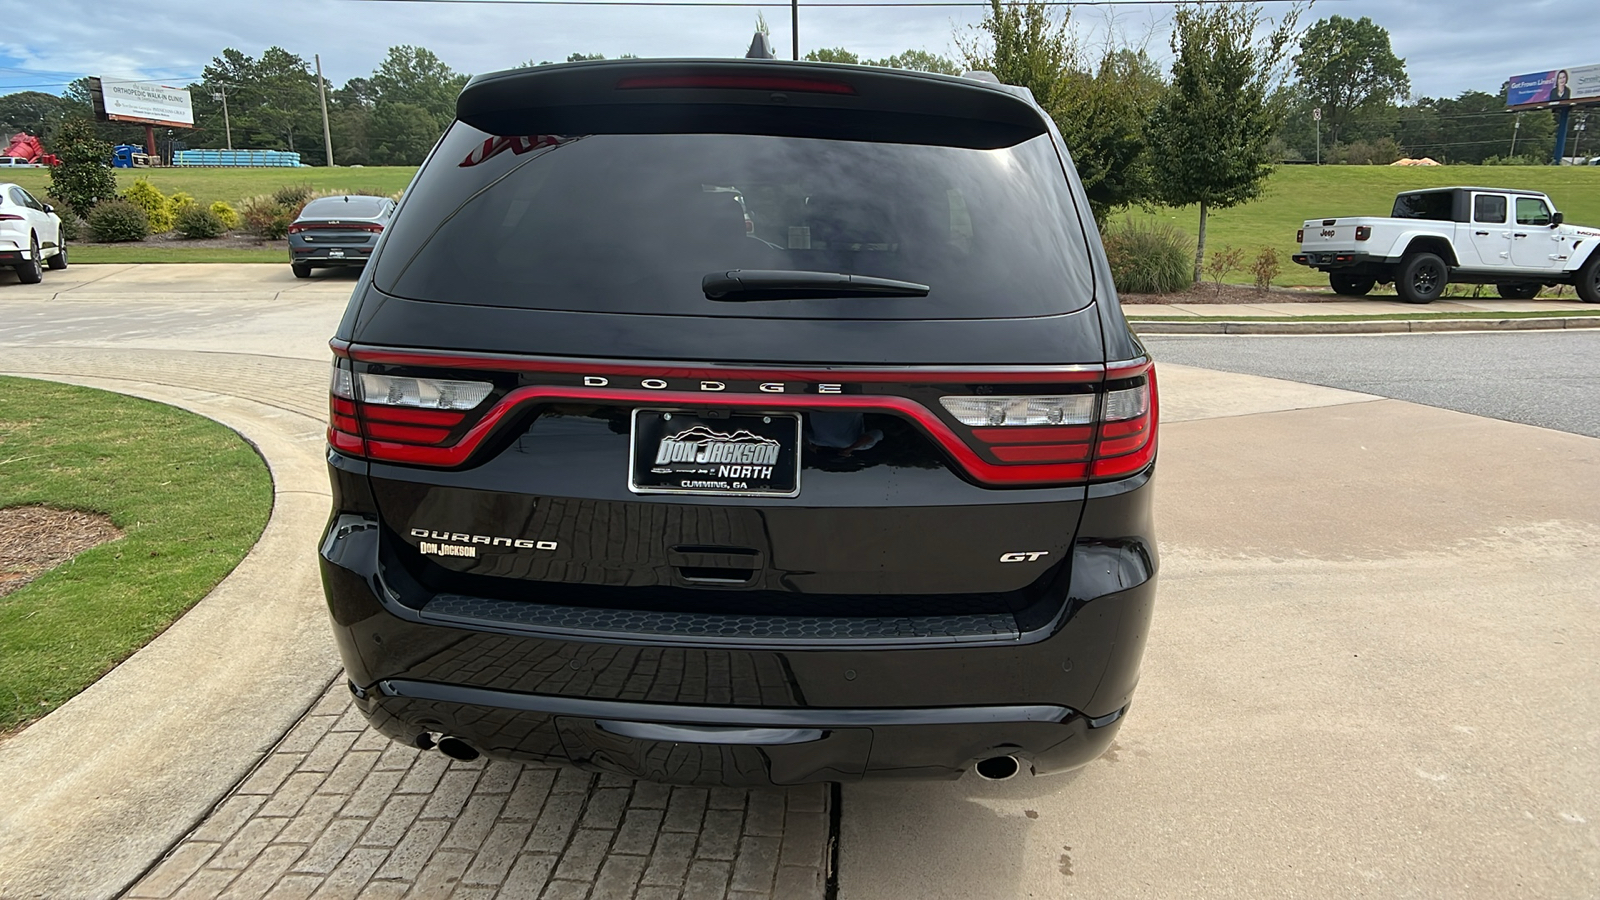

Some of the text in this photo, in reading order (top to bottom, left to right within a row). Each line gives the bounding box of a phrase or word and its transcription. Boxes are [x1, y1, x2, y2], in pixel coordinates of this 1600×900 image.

[113, 87, 146, 98] ORTHOPEDIC
[147, 91, 168, 100] WALK-IN
[168, 95, 183, 103] CLINIC
[1320, 228, 1335, 237] Jeep
[584, 376, 842, 394] DODGE
[718, 465, 773, 479] NORTH
[681, 480, 748, 489] CUMMING, GA
[410, 528, 558, 551] DURANGO
[999, 551, 1049, 563] GT
